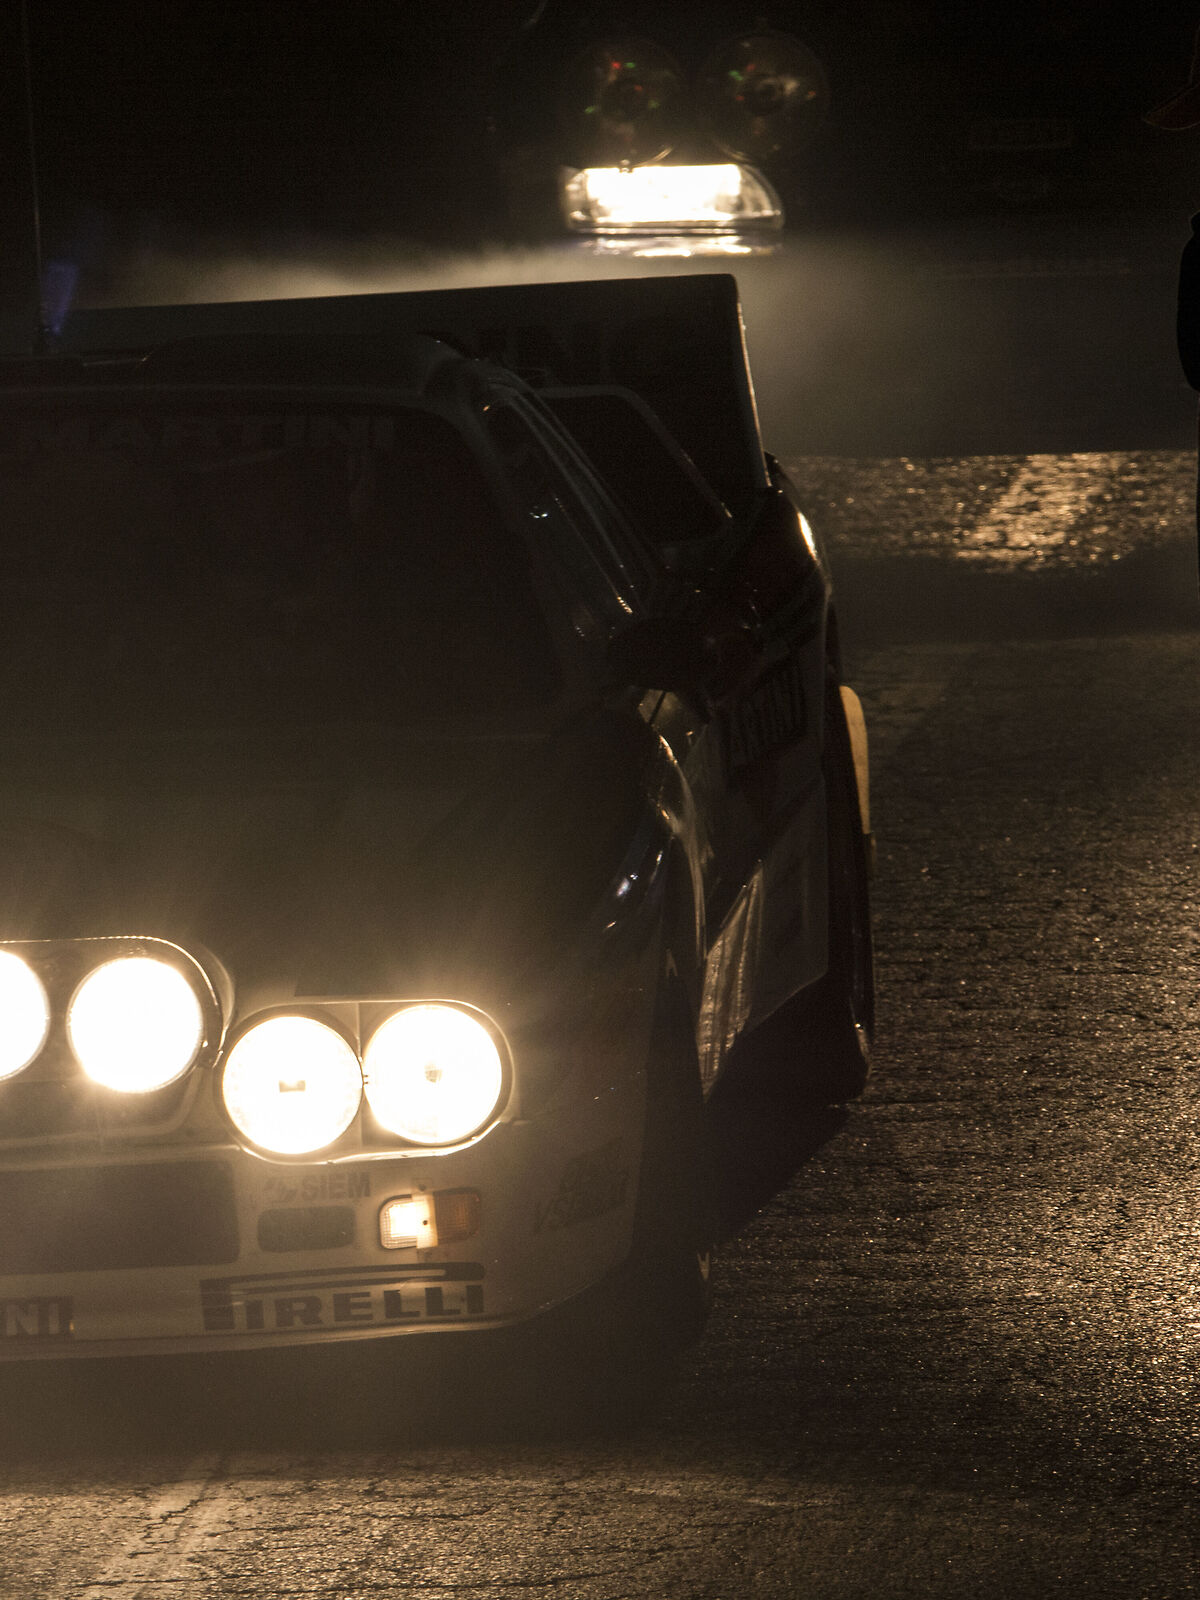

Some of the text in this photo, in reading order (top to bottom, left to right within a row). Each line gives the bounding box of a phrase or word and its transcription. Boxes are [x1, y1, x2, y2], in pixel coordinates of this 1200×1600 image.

[16, 414, 394, 456] MARTINI
[302, 1171, 371, 1200] SIEM
[200, 1262, 486, 1331] PIRELLI
